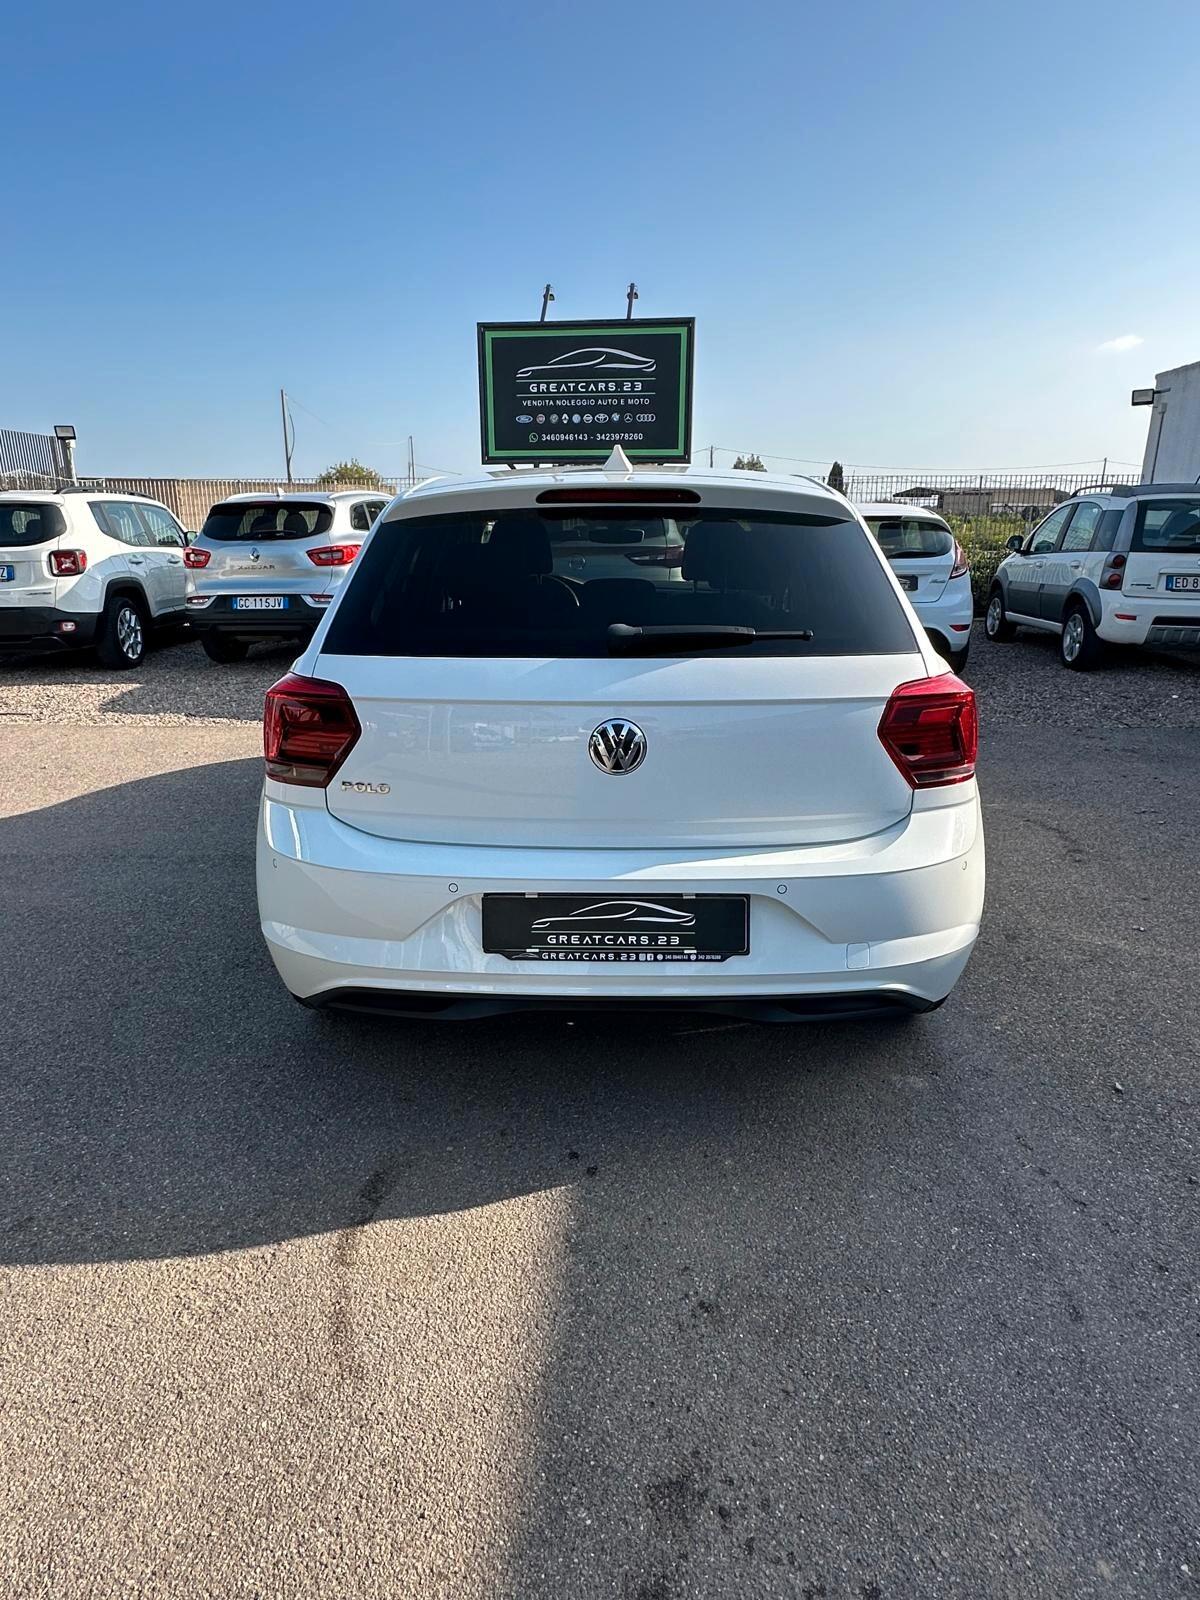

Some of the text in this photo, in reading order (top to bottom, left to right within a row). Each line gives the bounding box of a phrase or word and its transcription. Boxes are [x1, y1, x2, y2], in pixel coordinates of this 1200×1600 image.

[529, 382, 643, 393] GREATCARS.23
[522, 399, 555, 407] VENDITA
[597, 398, 618, 406] AUTO
[541, 433, 588, 441] 3460946143
[1174, 577, 1189, 588] ED
[238, 597, 283, 609] GC 115JV
[341, 780, 391, 794] POLO
[547, 934, 680, 945] GREATCARS.23
[541, 952, 636, 961] GREATCARS.23
